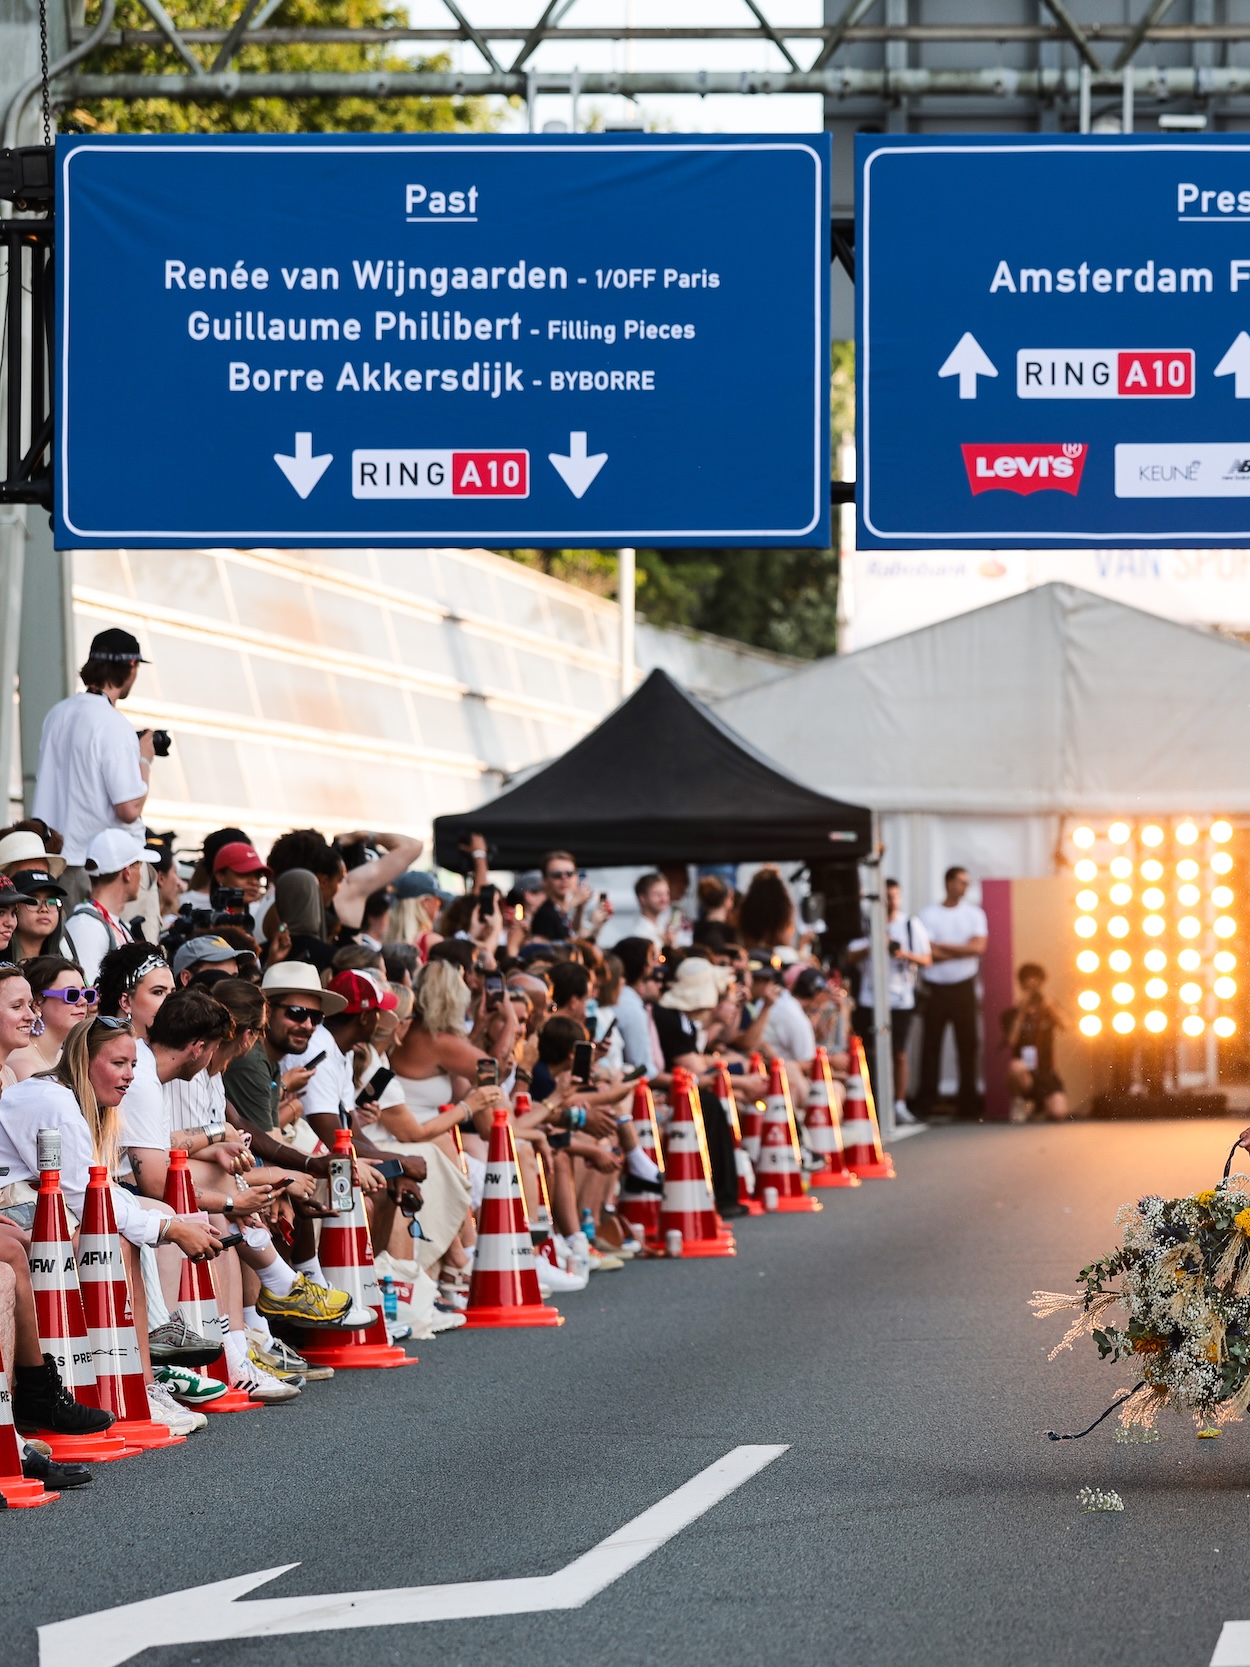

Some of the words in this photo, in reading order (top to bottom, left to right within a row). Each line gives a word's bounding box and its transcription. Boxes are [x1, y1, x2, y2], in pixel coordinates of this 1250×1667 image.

[405, 183, 479, 214] Past
[164, 259, 269, 290] Renée
[280, 267, 339, 290] van
[352, 259, 568, 298] Wijngaarden
[663, 267, 721, 289] Paris
[989, 259, 1213, 293] Amsterdam
[188, 310, 362, 341] Guillaume
[375, 310, 522, 341] Philibert
[548, 319, 616, 345] Filling
[624, 319, 696, 340] Pieces
[229, 361, 324, 392] Borre
[335, 361, 524, 399] Akkersdijk
[550, 370, 656, 391] BYBORRE
[1026, 361, 1110, 386] RING
[1124, 359, 1185, 388] A10
[360, 462, 444, 486] RING
[459, 460, 520, 488] A10
[1139, 465, 1198, 481] KEUNE
[80, 1251, 113, 1266] AFW
